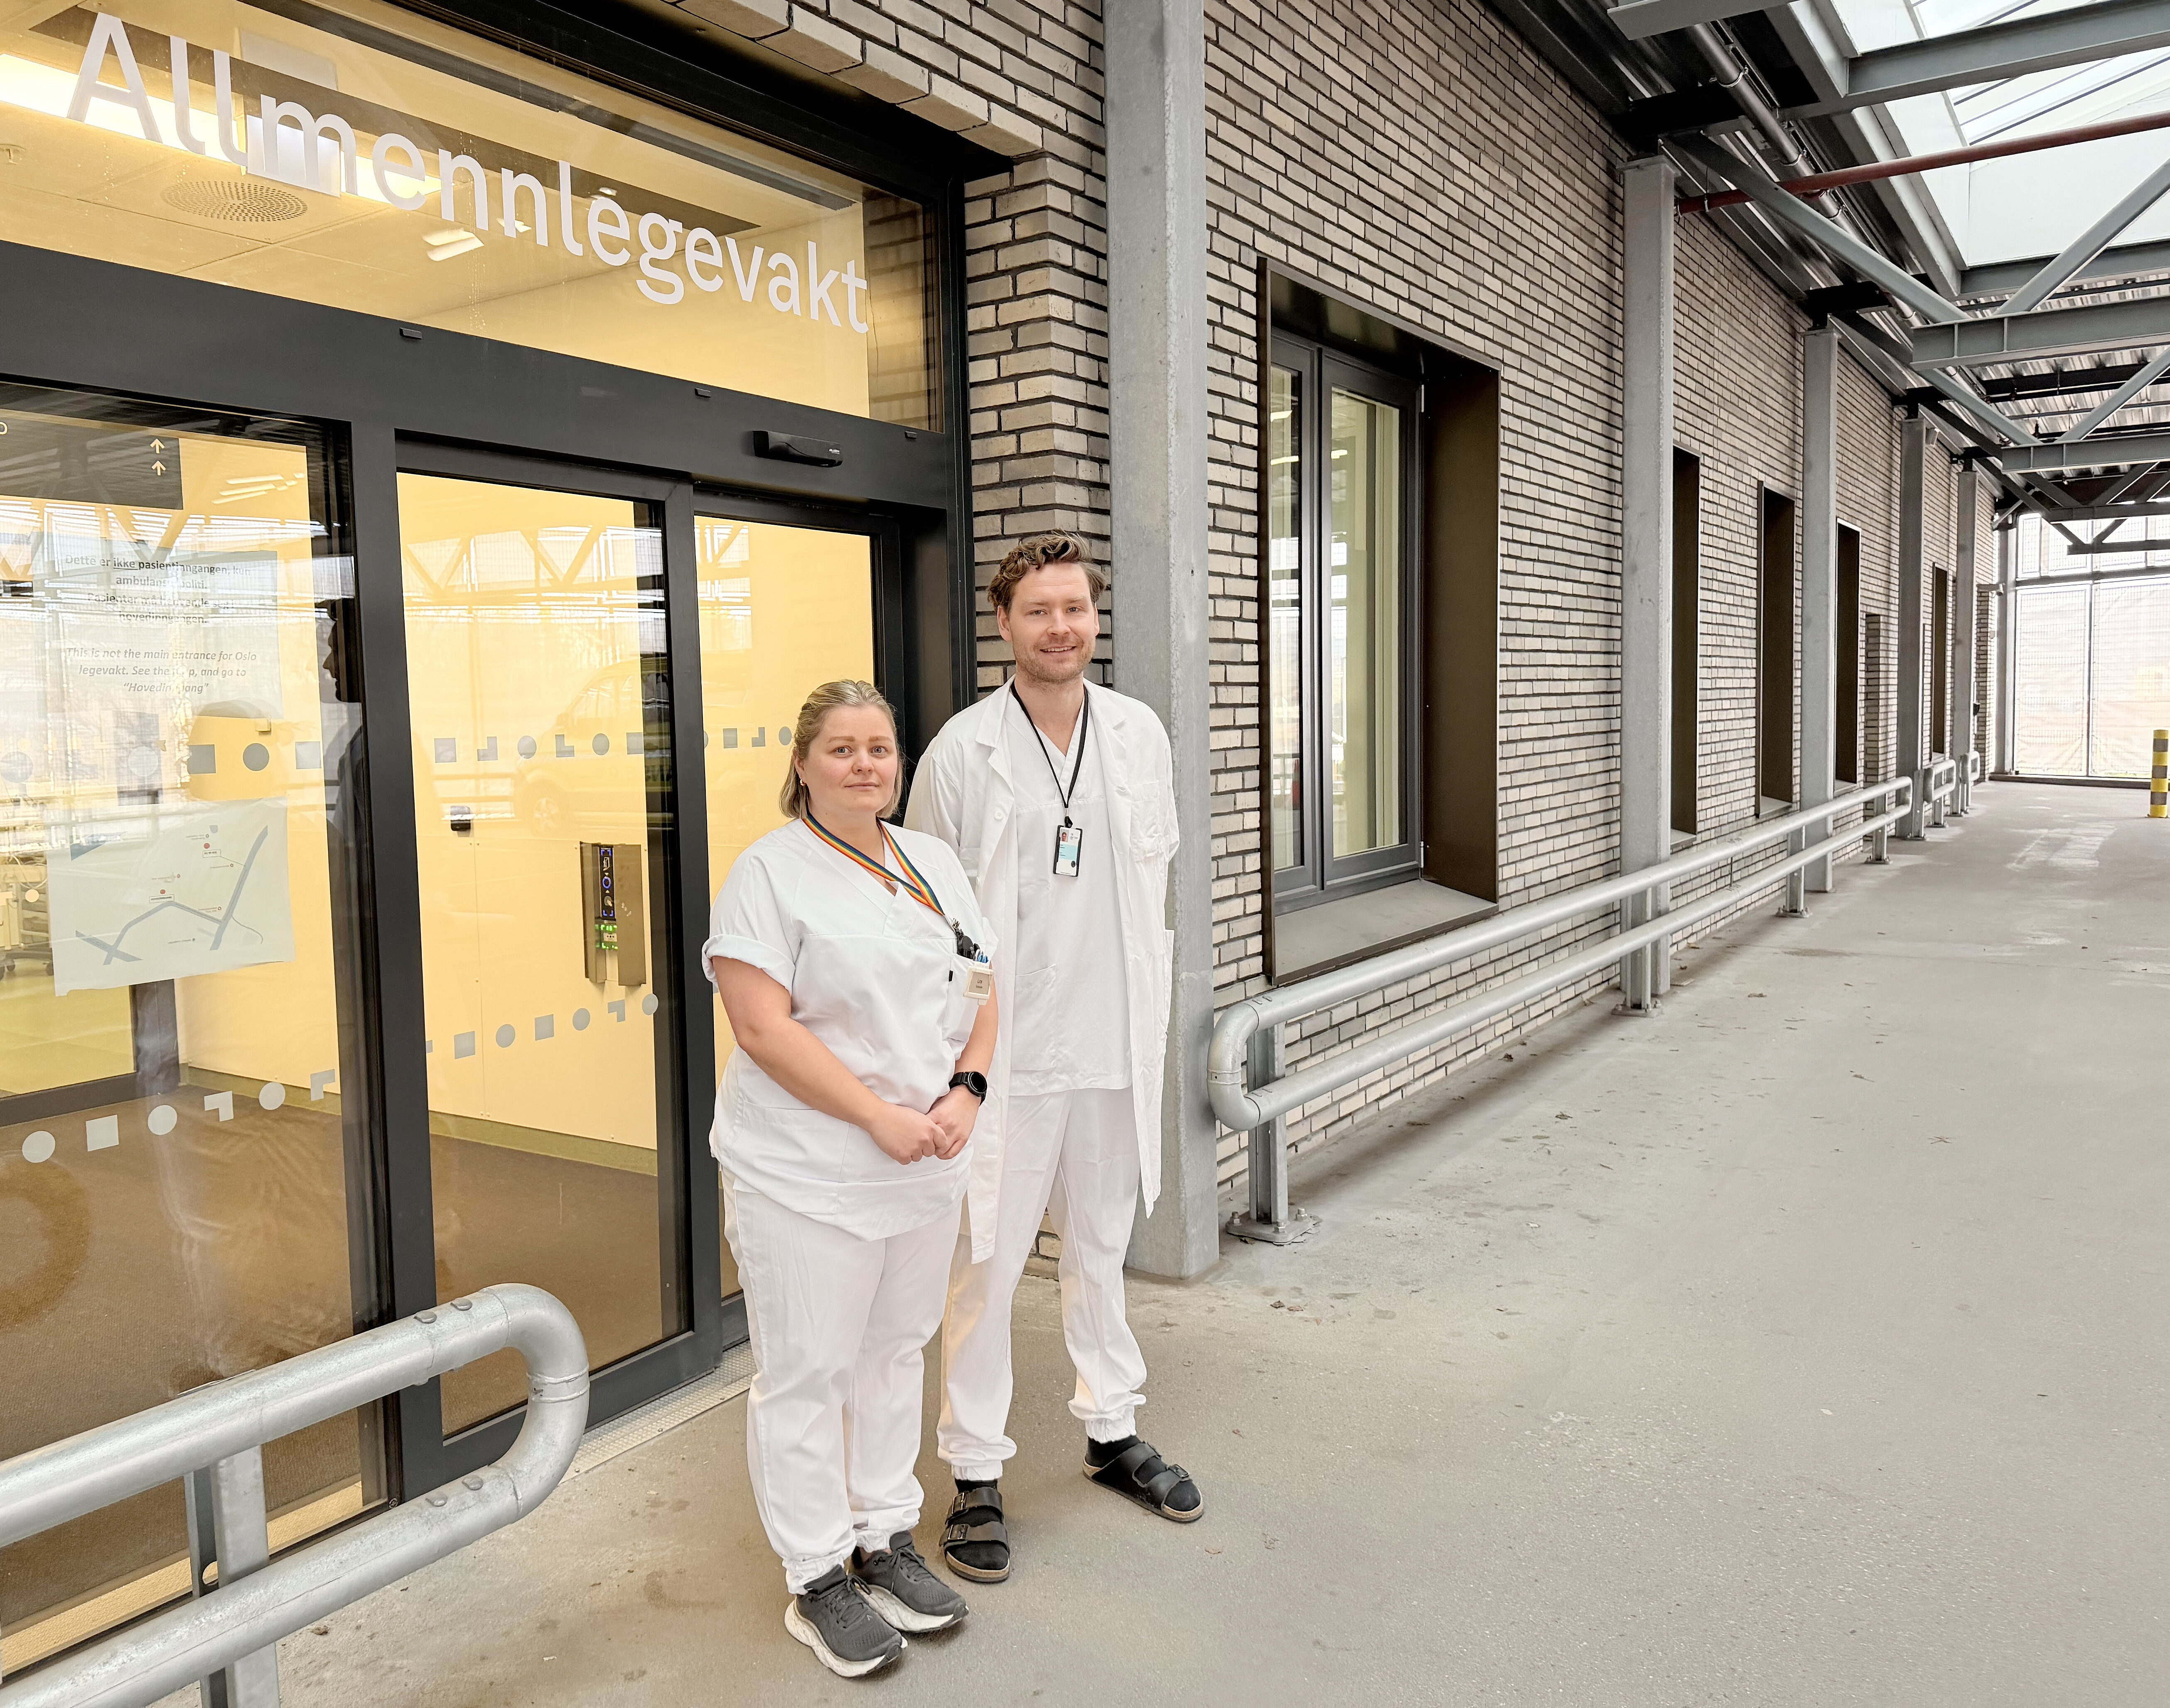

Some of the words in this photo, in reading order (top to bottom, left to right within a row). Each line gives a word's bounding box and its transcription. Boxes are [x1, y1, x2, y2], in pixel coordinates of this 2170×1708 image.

[66, 12, 869, 334] Allmennlegevakt
[66, 555, 96, 565] Dette
[113, 557, 135, 568] ikke
[233, 566, 251, 576] kun
[66, 647, 88, 657] This
[91, 648, 100, 658] is
[103, 649, 121, 658] not
[124, 649, 141, 659] the
[144, 650, 169, 659] main
[172, 651, 216, 660] entrance
[218, 651, 233, 662] for
[235, 651, 257, 661] Oslo
[79, 665, 128, 677] legevakt.
[131, 666, 150, 675] See
[153, 666, 169, 675] the
[201, 667, 219, 676] and
[221, 669, 233, 678] go
[236, 668, 246, 676] to
[123, 682, 209, 694] “Hovedinang”
